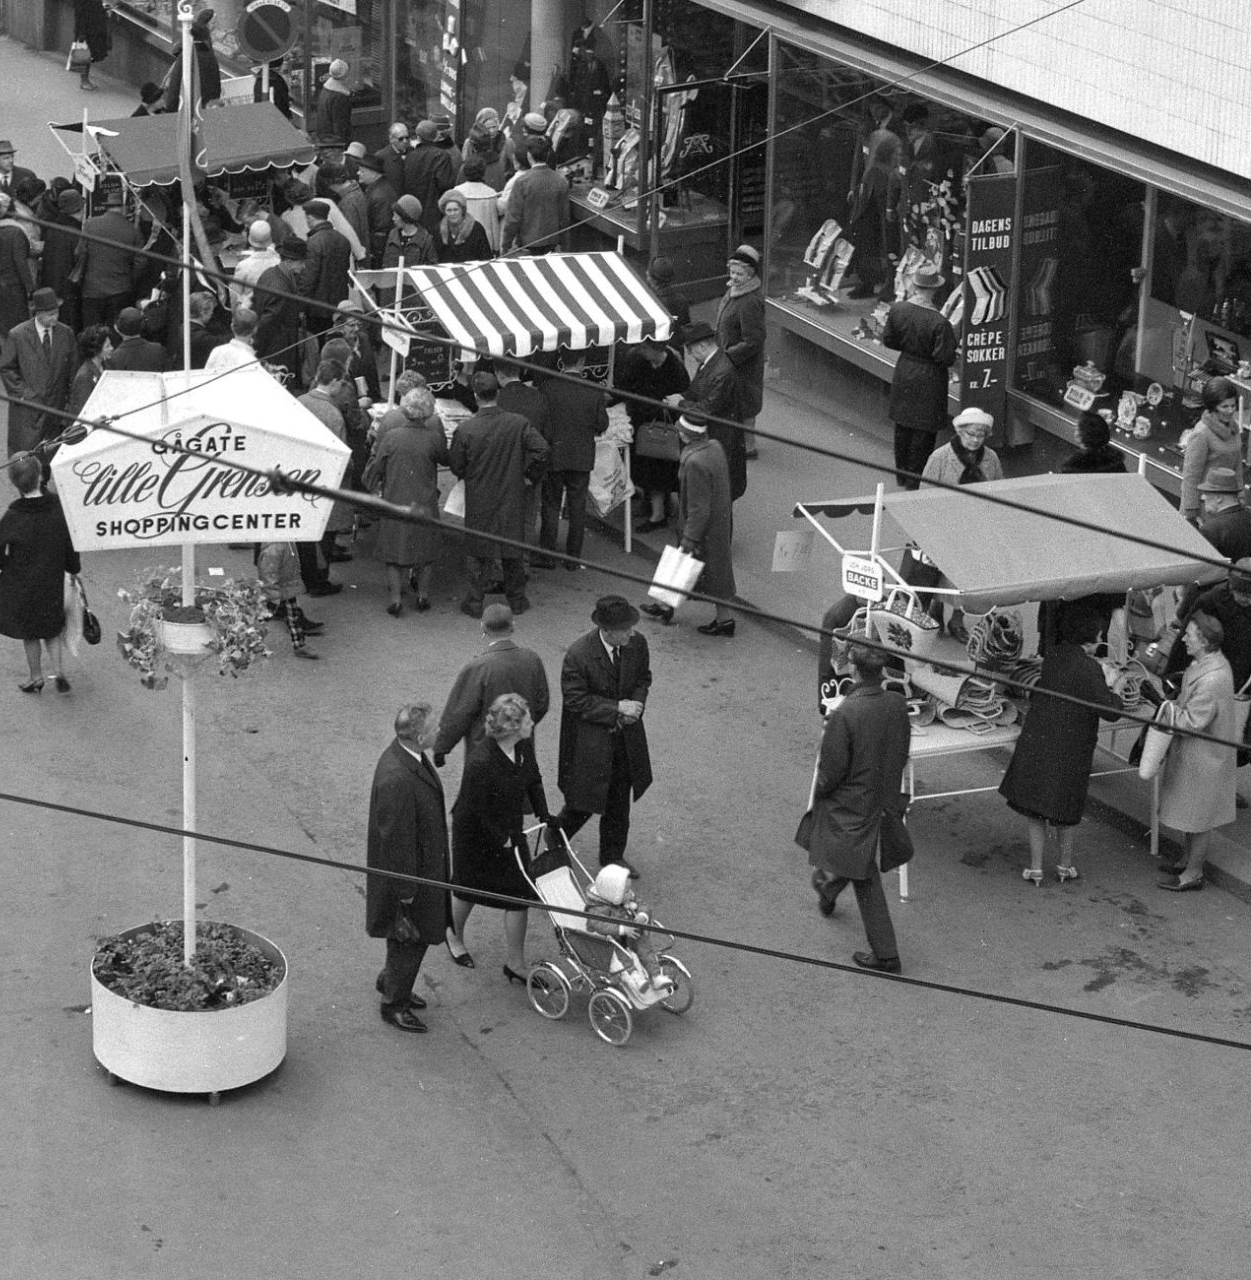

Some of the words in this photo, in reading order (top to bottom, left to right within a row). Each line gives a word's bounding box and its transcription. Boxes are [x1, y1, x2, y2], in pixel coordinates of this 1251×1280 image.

[971, 217, 1012, 235] DAGENS
[971, 234, 1010, 251] TILBUD
[966, 328, 1003, 347] CRÈPE
[966, 346, 1006, 363] SOKKER
[151, 432, 247, 456] GÅGATE
[847, 571, 877, 589] BACKE
